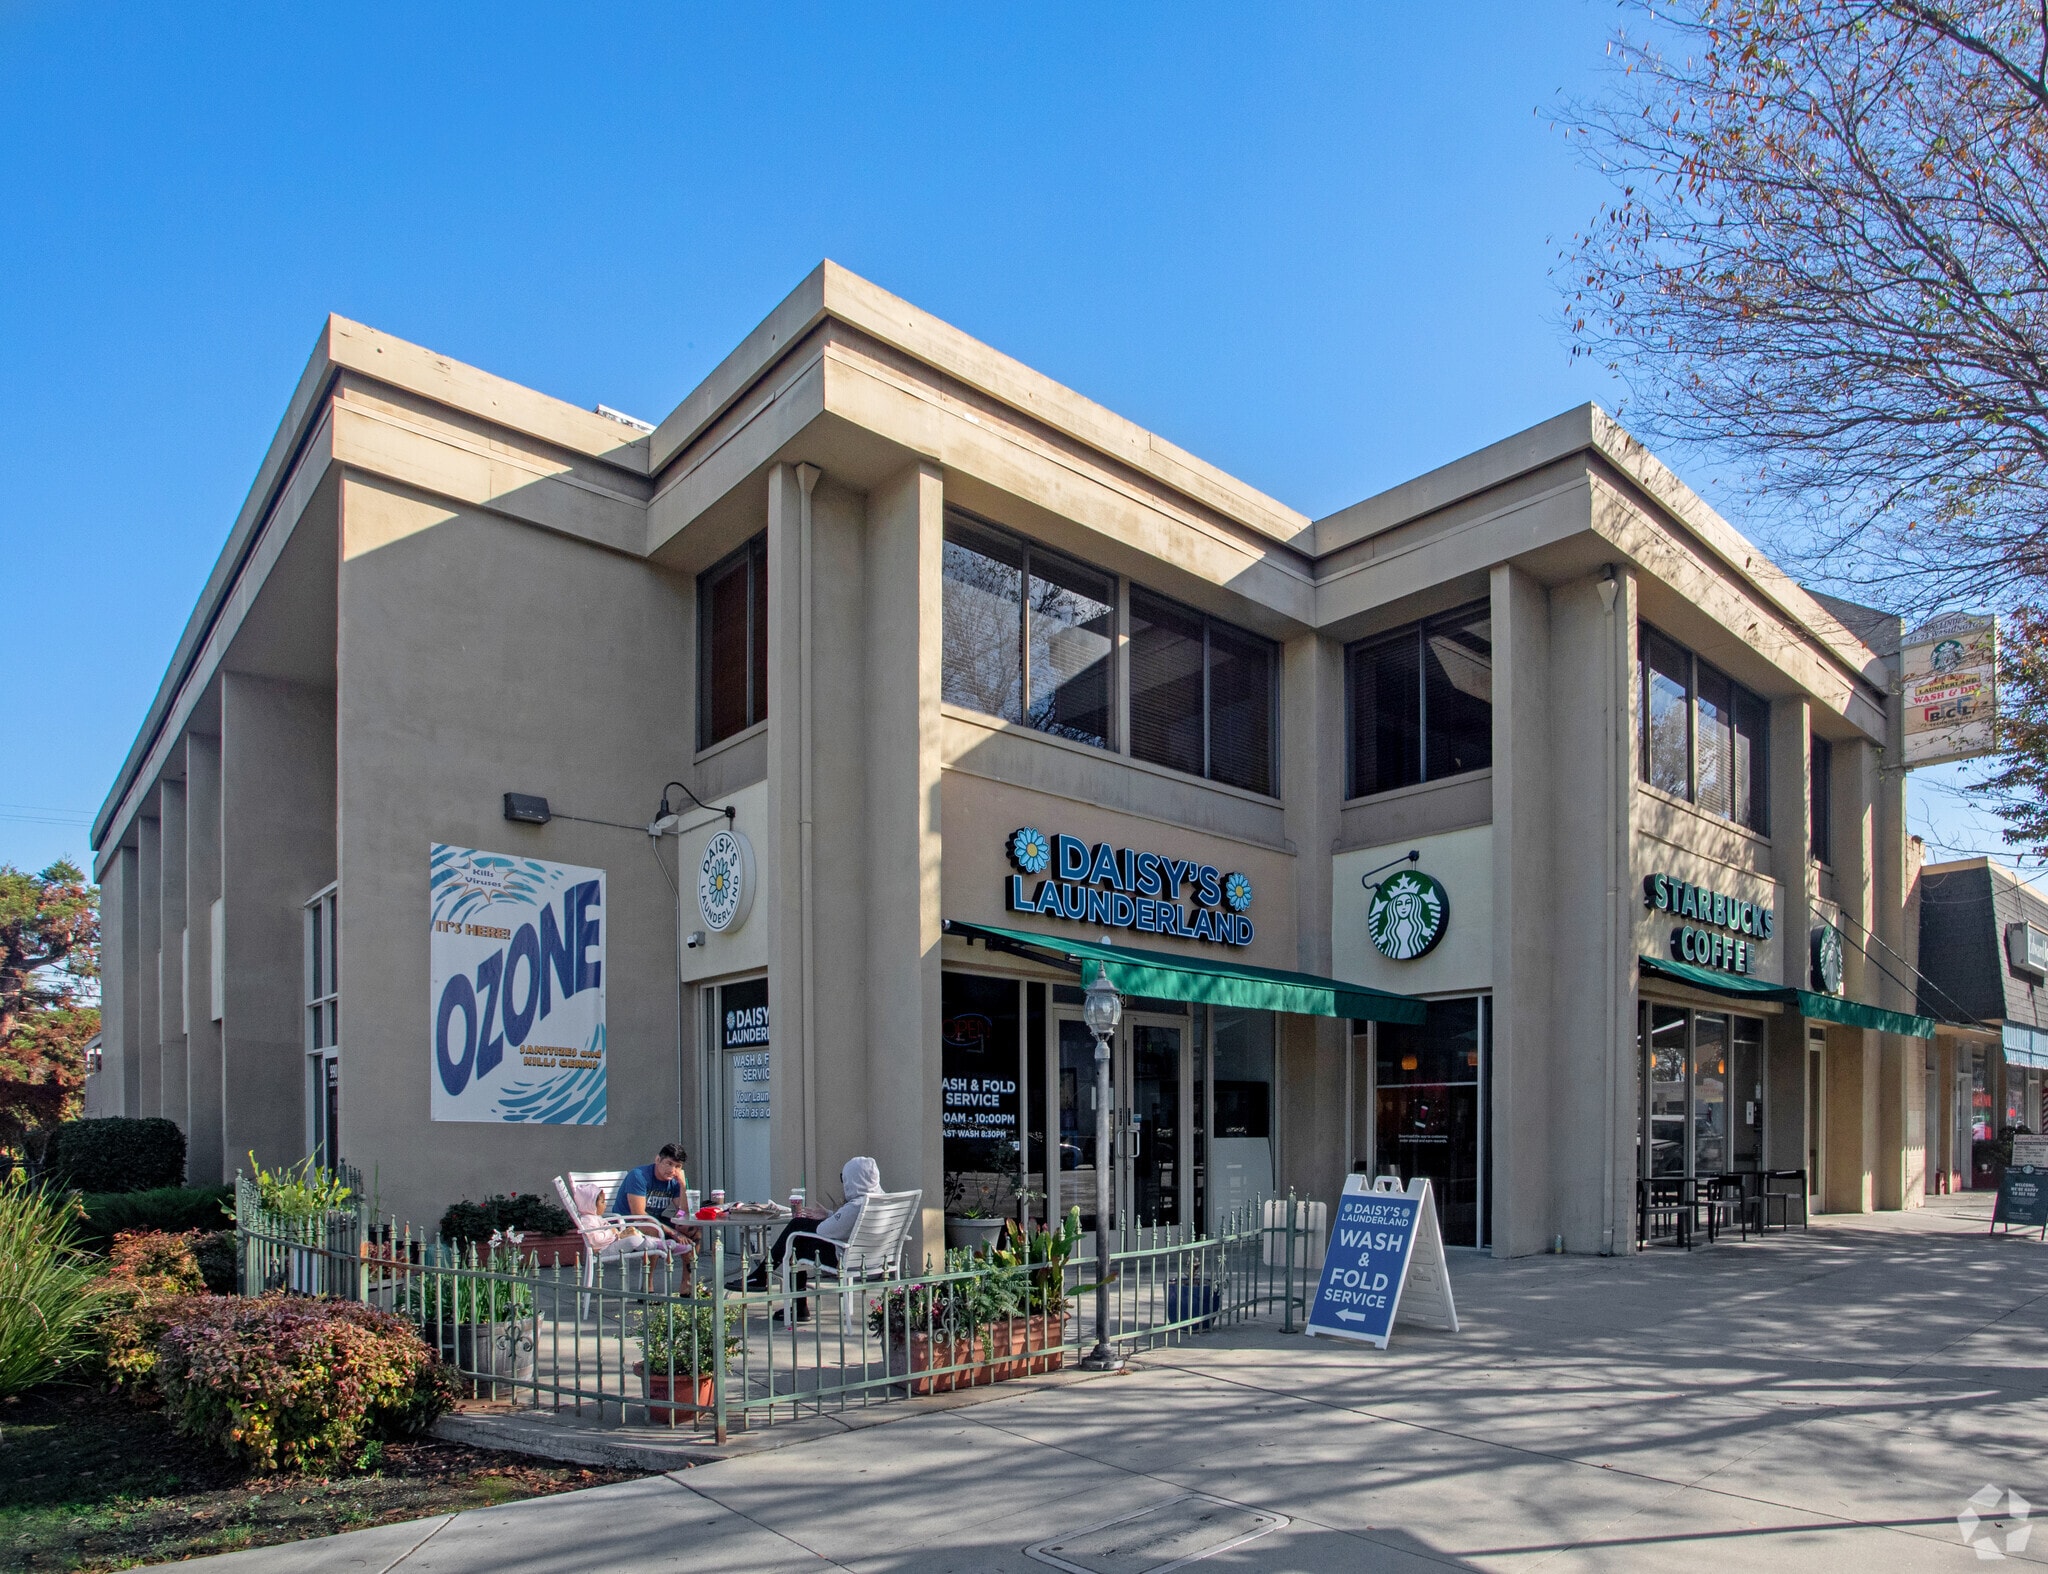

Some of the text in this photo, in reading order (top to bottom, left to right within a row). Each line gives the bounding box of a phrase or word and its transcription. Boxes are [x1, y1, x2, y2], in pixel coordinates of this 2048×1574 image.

[1914, 682, 1982, 704] WASH & DRY
[1919, 677, 1977, 695] LAUNDERLAND
[1930, 706, 1972, 722] BCL
[703, 837, 738, 875] DAISY'S
[472, 868, 494, 878] Kills
[1057, 833, 1222, 907] DAISY'S
[465, 876, 502, 888] Viruses
[701, 875, 739, 924] LAUNDERLAND
[1653, 871, 1775, 941] STARBUCKS
[1012, 874, 1255, 946] LAUNDERLAND
[435, 920, 511, 940] IT'S HERE!
[1680, 925, 1757, 976] COFFEE
[436, 879, 601, 1096] OZONE
[736, 1006, 769, 1028] DAISY
[942, 1019, 990, 1039] OPEN
[519, 1044, 601, 1059] SANITIZES and
[523, 1057, 598, 1070] KILLS GERMS
[733, 1054, 756, 1068] WASH
[757, 1054, 762, 1065] &
[970, 1079, 979, 1091] &
[982, 1080, 1016, 1093] FOLD
[736, 1090, 751, 1102] Your
[945, 1093, 1000, 1107] SERVICE
[733, 1107, 749, 1118] fresh
[751, 1109, 758, 1117] as
[975, 1113, 1015, 1124] 10:00PM
[958, 1130, 980, 1138] WASH
[981, 1130, 1007, 1138] 8:30PM
[1354, 1203, 1400, 1217] DAISY'S
[1341, 1213, 1409, 1227] LAUNDERLAND
[1340, 1229, 1403, 1252] WASH
[1358, 1252, 1369, 1267] &
[1330, 1267, 1389, 1291] FOLD
[1324, 1288, 1386, 1309] SERVICE
